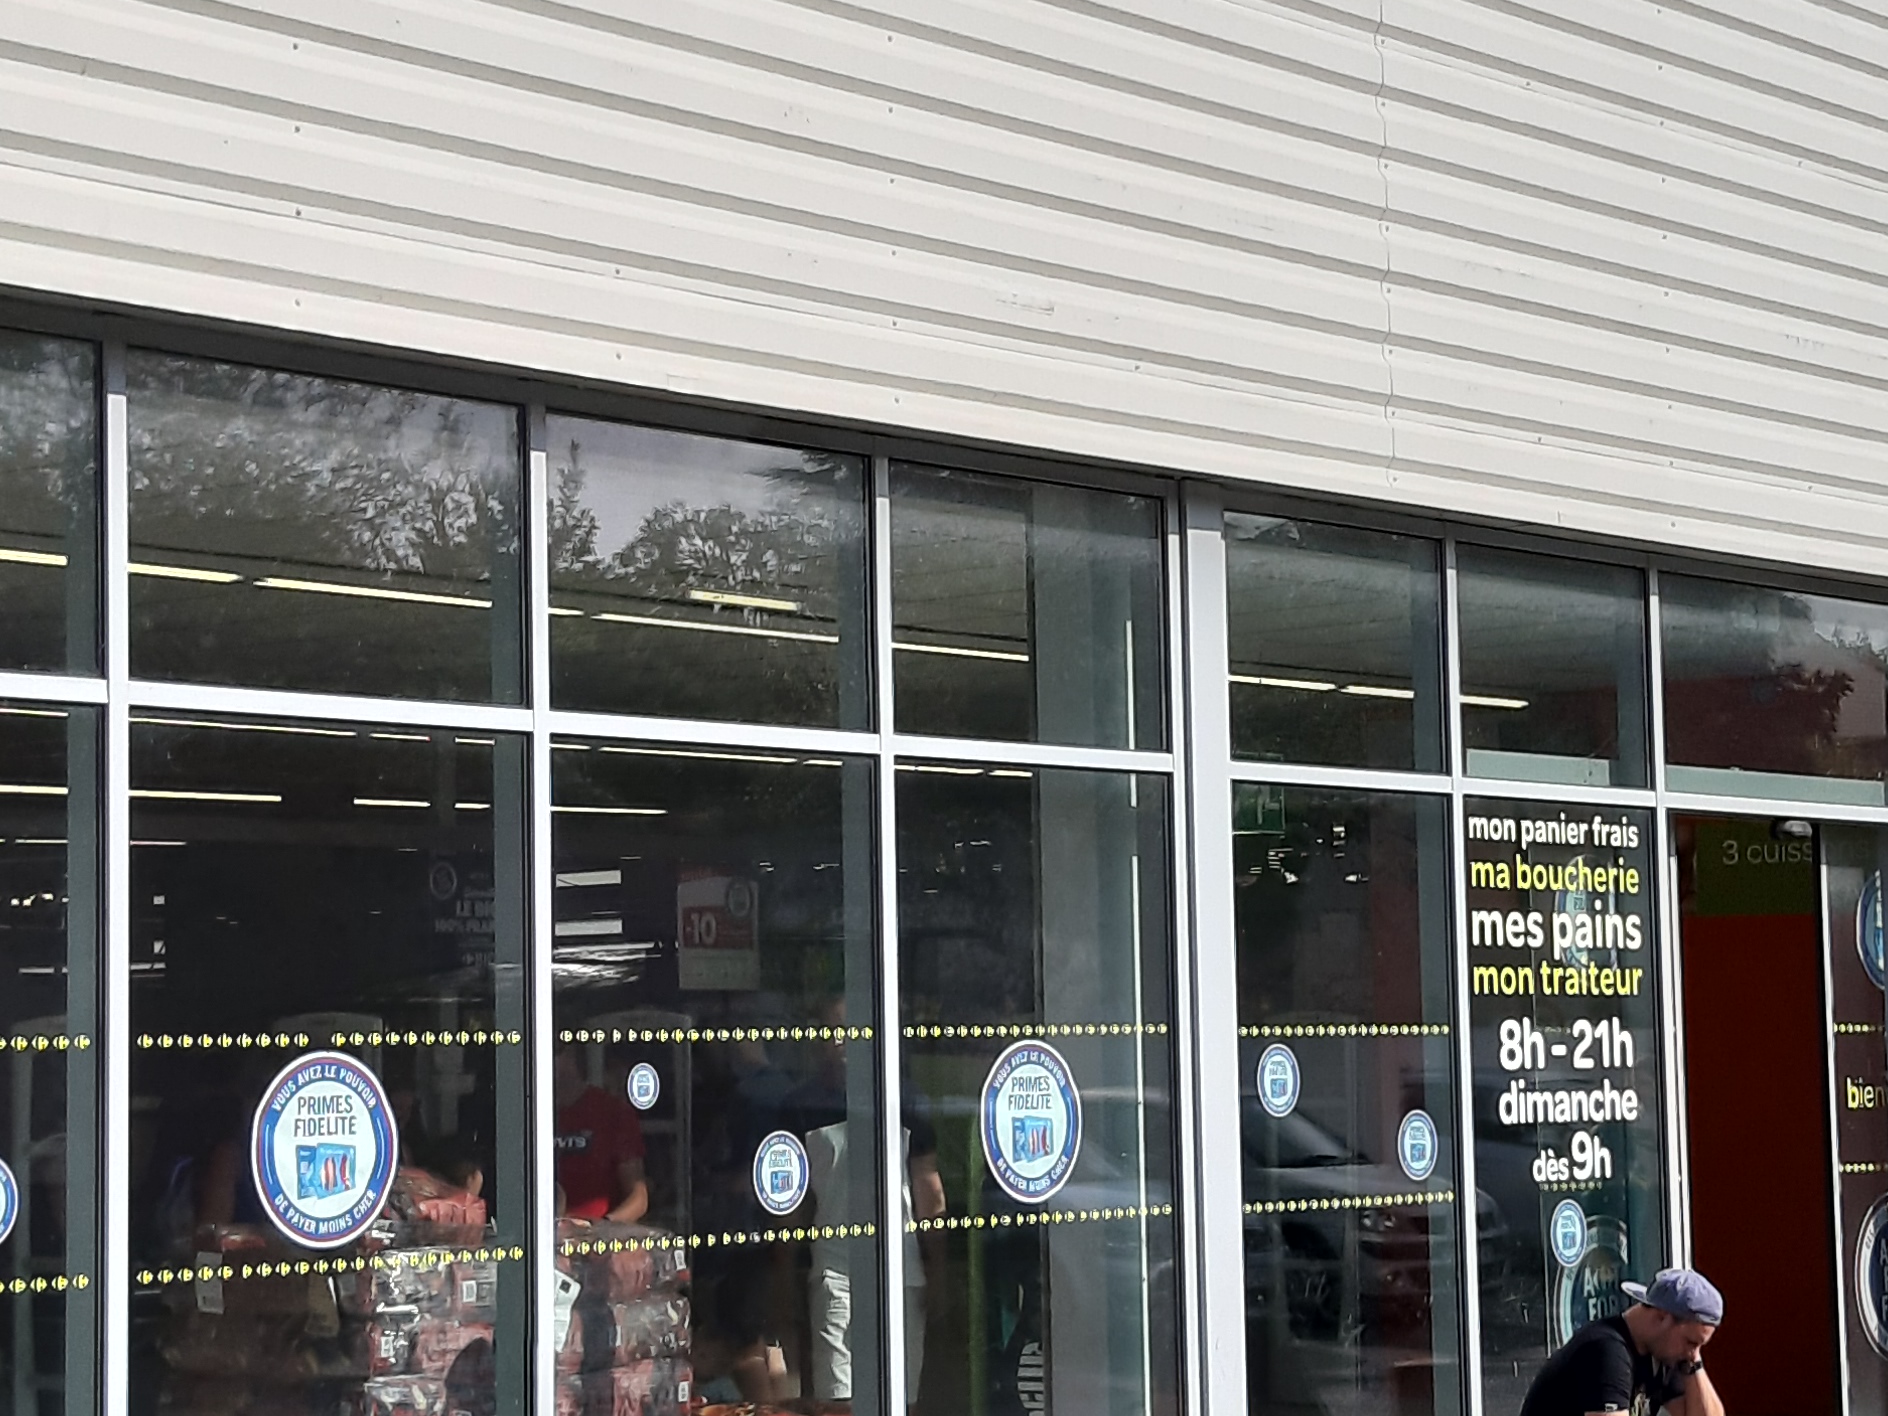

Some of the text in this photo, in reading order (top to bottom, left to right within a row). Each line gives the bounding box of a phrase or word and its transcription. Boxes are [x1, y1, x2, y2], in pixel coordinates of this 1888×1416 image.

[1468, 811, 1639, 851] mon panier frais
[1721, 840, 1740, 865] 3
[1470, 853, 1639, 894] ma boucherie
[1471, 899, 1642, 961] mes pains
[1473, 960, 1643, 996] mon traiteur
[1499, 1016, 1546, 1071] 8h
[1572, 1016, 1634, 1069] 21h
[271, 1064, 377, 1113] VOUS AVEZ LE POUVOIR
[297, 1094, 353, 1115] PRIMES
[1011, 1075, 1050, 1092] PRIMES
[1498, 1078, 1638, 1125] dimanche
[1532, 1131, 1612, 1182] dès 9h
[274, 1189, 376, 1234] DE PAYER MOINS CHER
